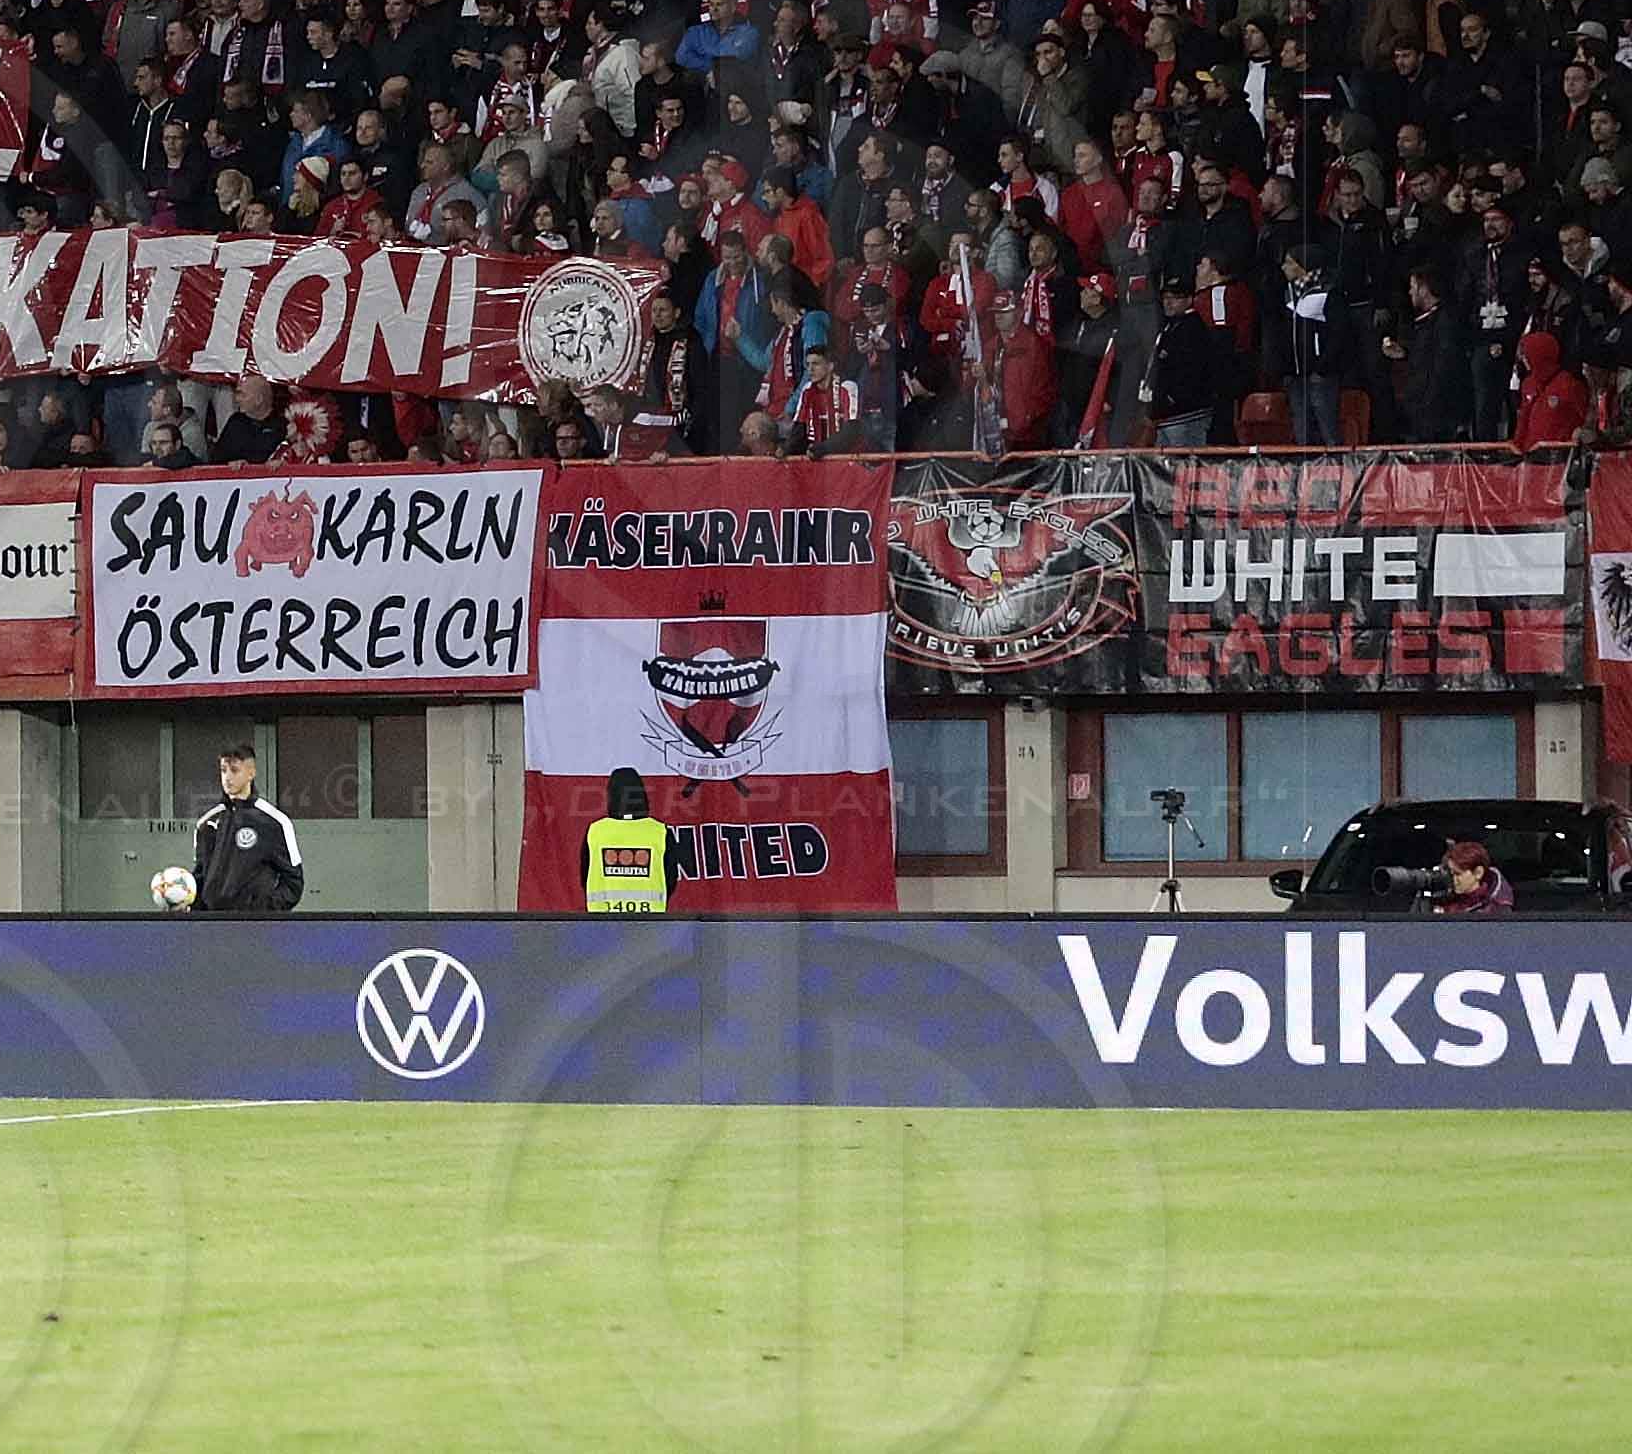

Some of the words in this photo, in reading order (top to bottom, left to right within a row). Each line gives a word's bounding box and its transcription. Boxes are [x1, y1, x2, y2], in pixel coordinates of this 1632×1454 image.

[104, 490, 241, 574] SAU
[316, 487, 526, 568] KARLN
[1173, 463, 1351, 531] RED
[913, 497, 993, 526] WHITE
[1008, 501, 1128, 568] EAGLES
[1168, 535, 1419, 603] WHITE
[116, 594, 524, 681] ÖSTERREICH
[888, 612, 977, 657] RIBUS
[995, 606, 1081, 658] UNITIS
[1164, 609, 1494, 677] EAGLES
[666, 821, 830, 881] NITED
[1058, 931, 1632, 1066] Volksw
